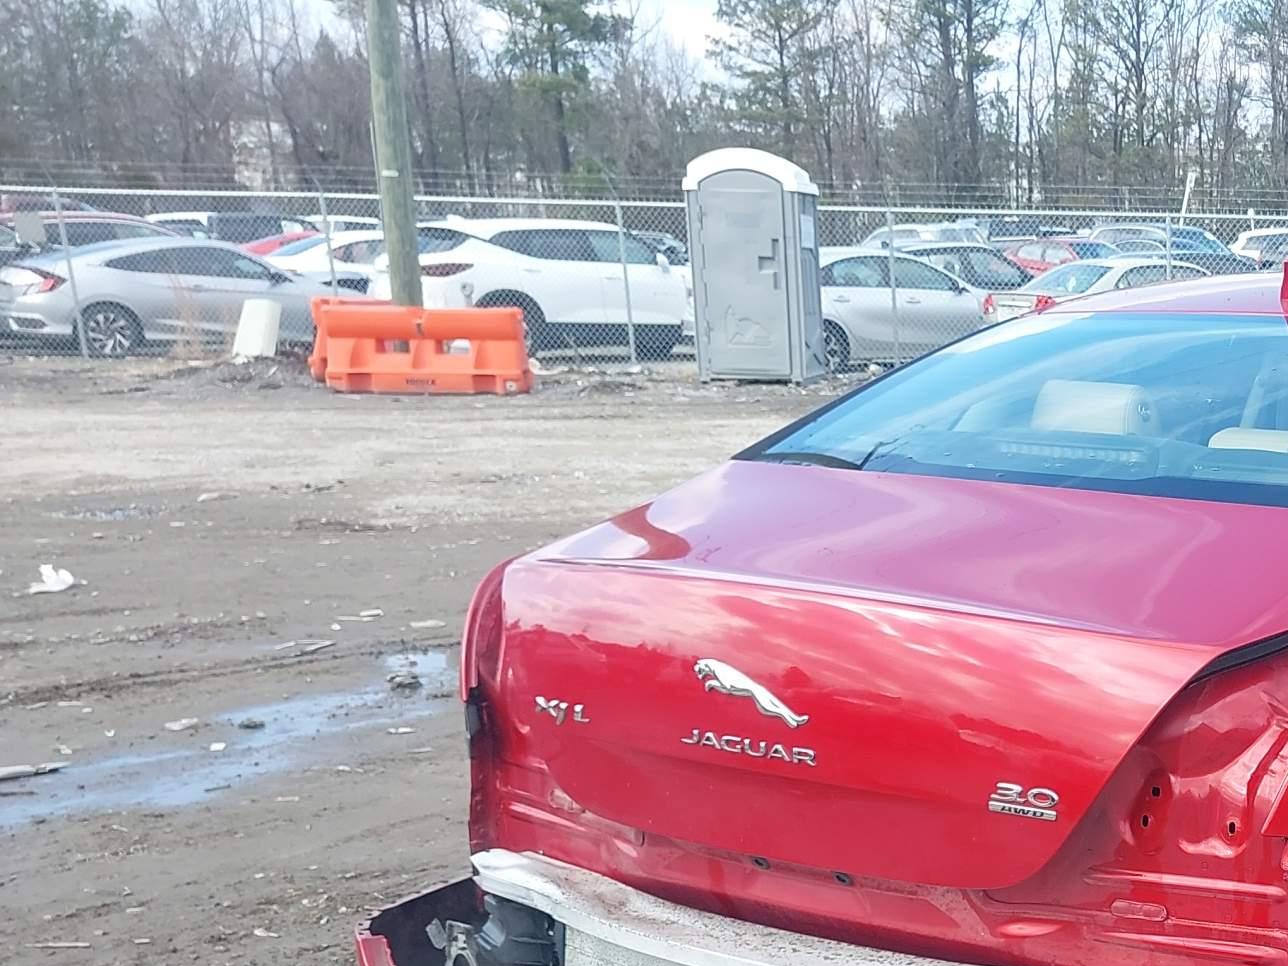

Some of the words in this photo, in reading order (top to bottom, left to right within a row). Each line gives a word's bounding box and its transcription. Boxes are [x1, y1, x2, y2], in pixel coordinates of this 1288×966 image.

[680, 728, 818, 767] JAGUAR
[989, 781, 1059, 808] 3.0
[1000, 805, 1045, 818] AWD
